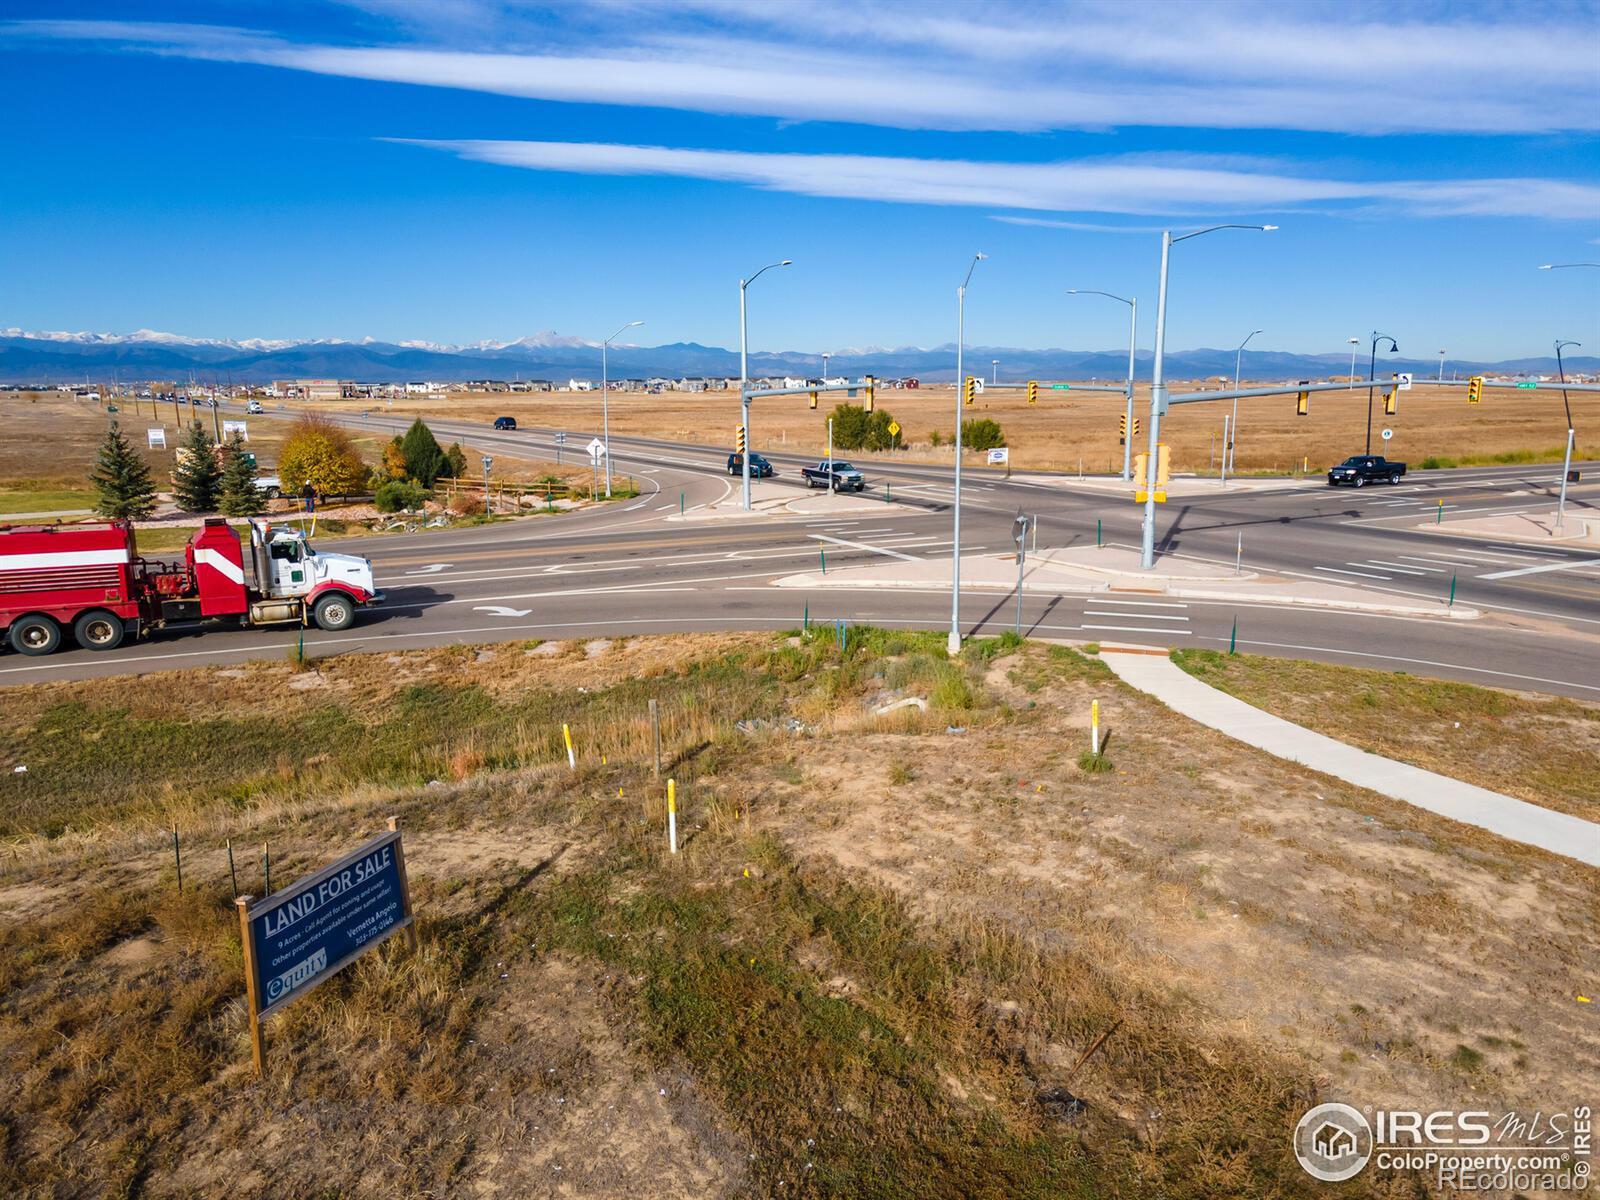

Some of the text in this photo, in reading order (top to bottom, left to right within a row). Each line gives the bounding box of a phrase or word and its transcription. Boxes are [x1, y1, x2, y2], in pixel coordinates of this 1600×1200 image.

[264, 847, 390, 937] LAND FOR SALE
[284, 932, 301, 947] Acres
[305, 921, 315, 933] Call
[316, 911, 332, 926] Agent
[332, 906, 340, 915] for
[341, 895, 360, 910] zoning
[361, 887, 371, 898] and
[375, 901, 397, 920] Angelo
[272, 951, 291, 967] Other
[292, 932, 321, 957] properties
[322, 915, 346, 935] available
[347, 905, 363, 919] under
[267, 951, 326, 1000] equity
